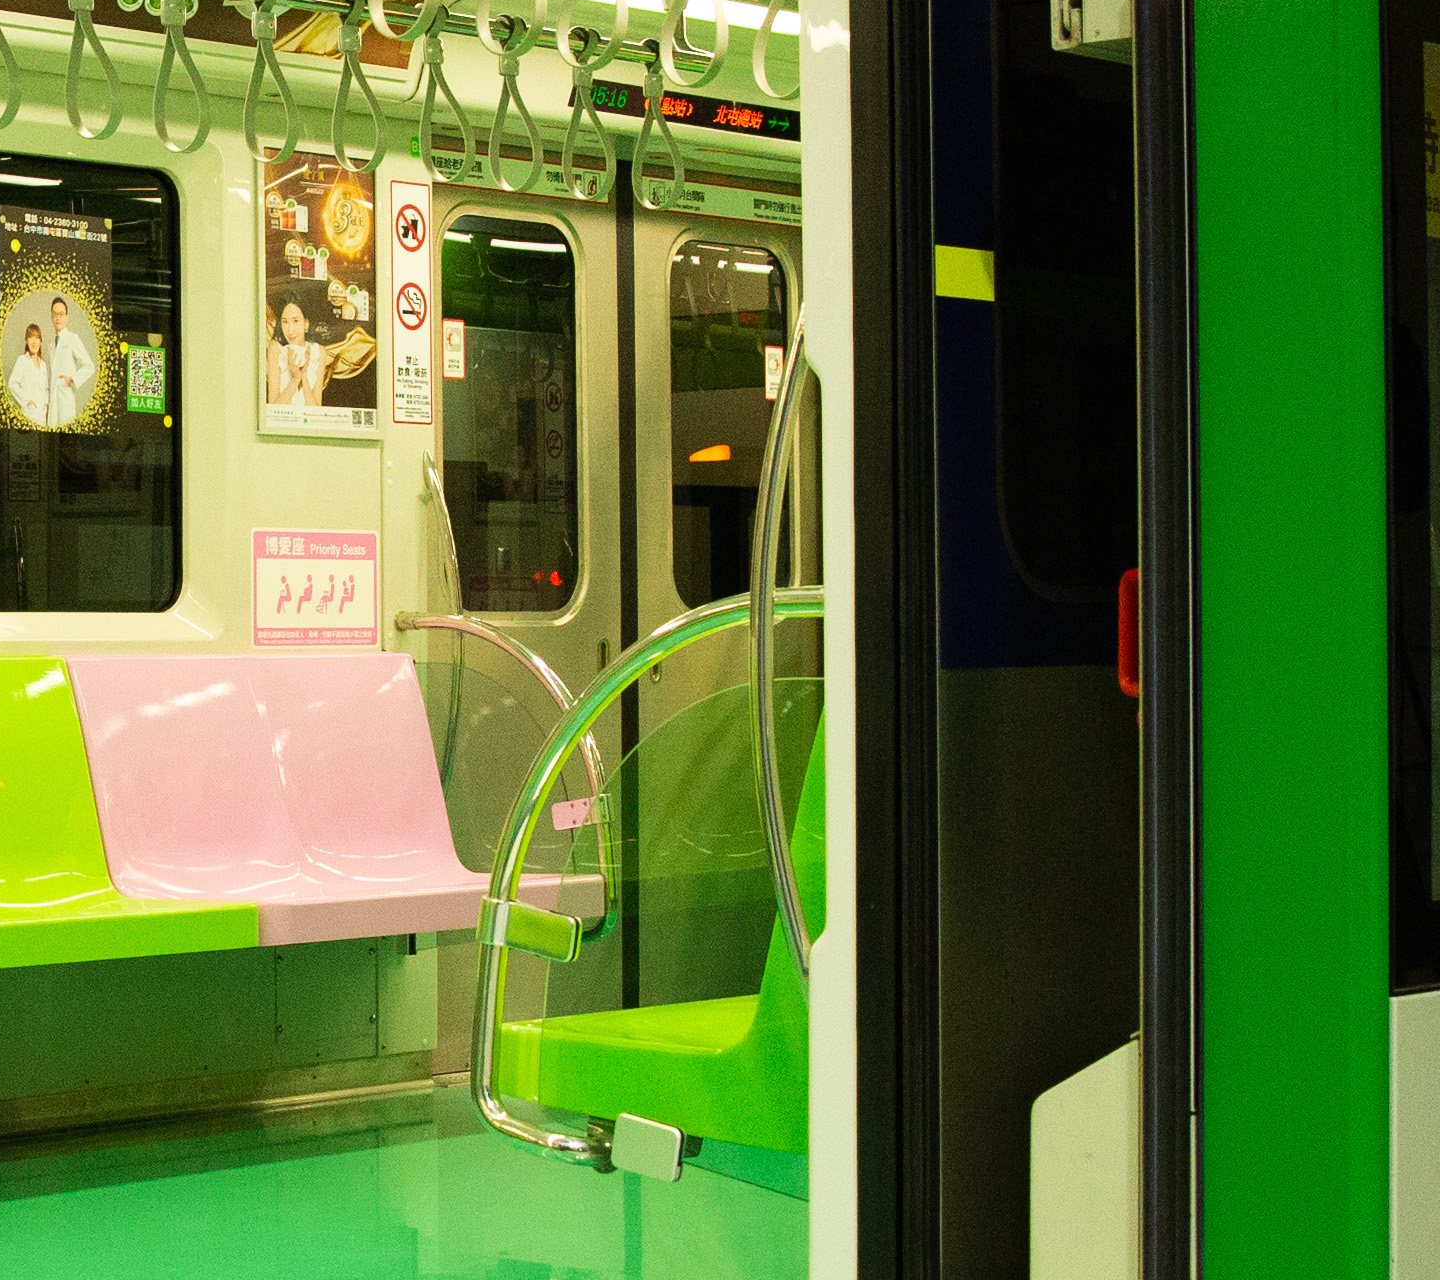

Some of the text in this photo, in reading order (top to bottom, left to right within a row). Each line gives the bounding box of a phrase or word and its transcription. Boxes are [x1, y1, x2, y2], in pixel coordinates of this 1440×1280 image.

[712, 104, 764, 130] 北屯總站
[130, 397, 162, 410] 加入好友
[264, 535, 367, 558] 博愛座 Priority Seats
